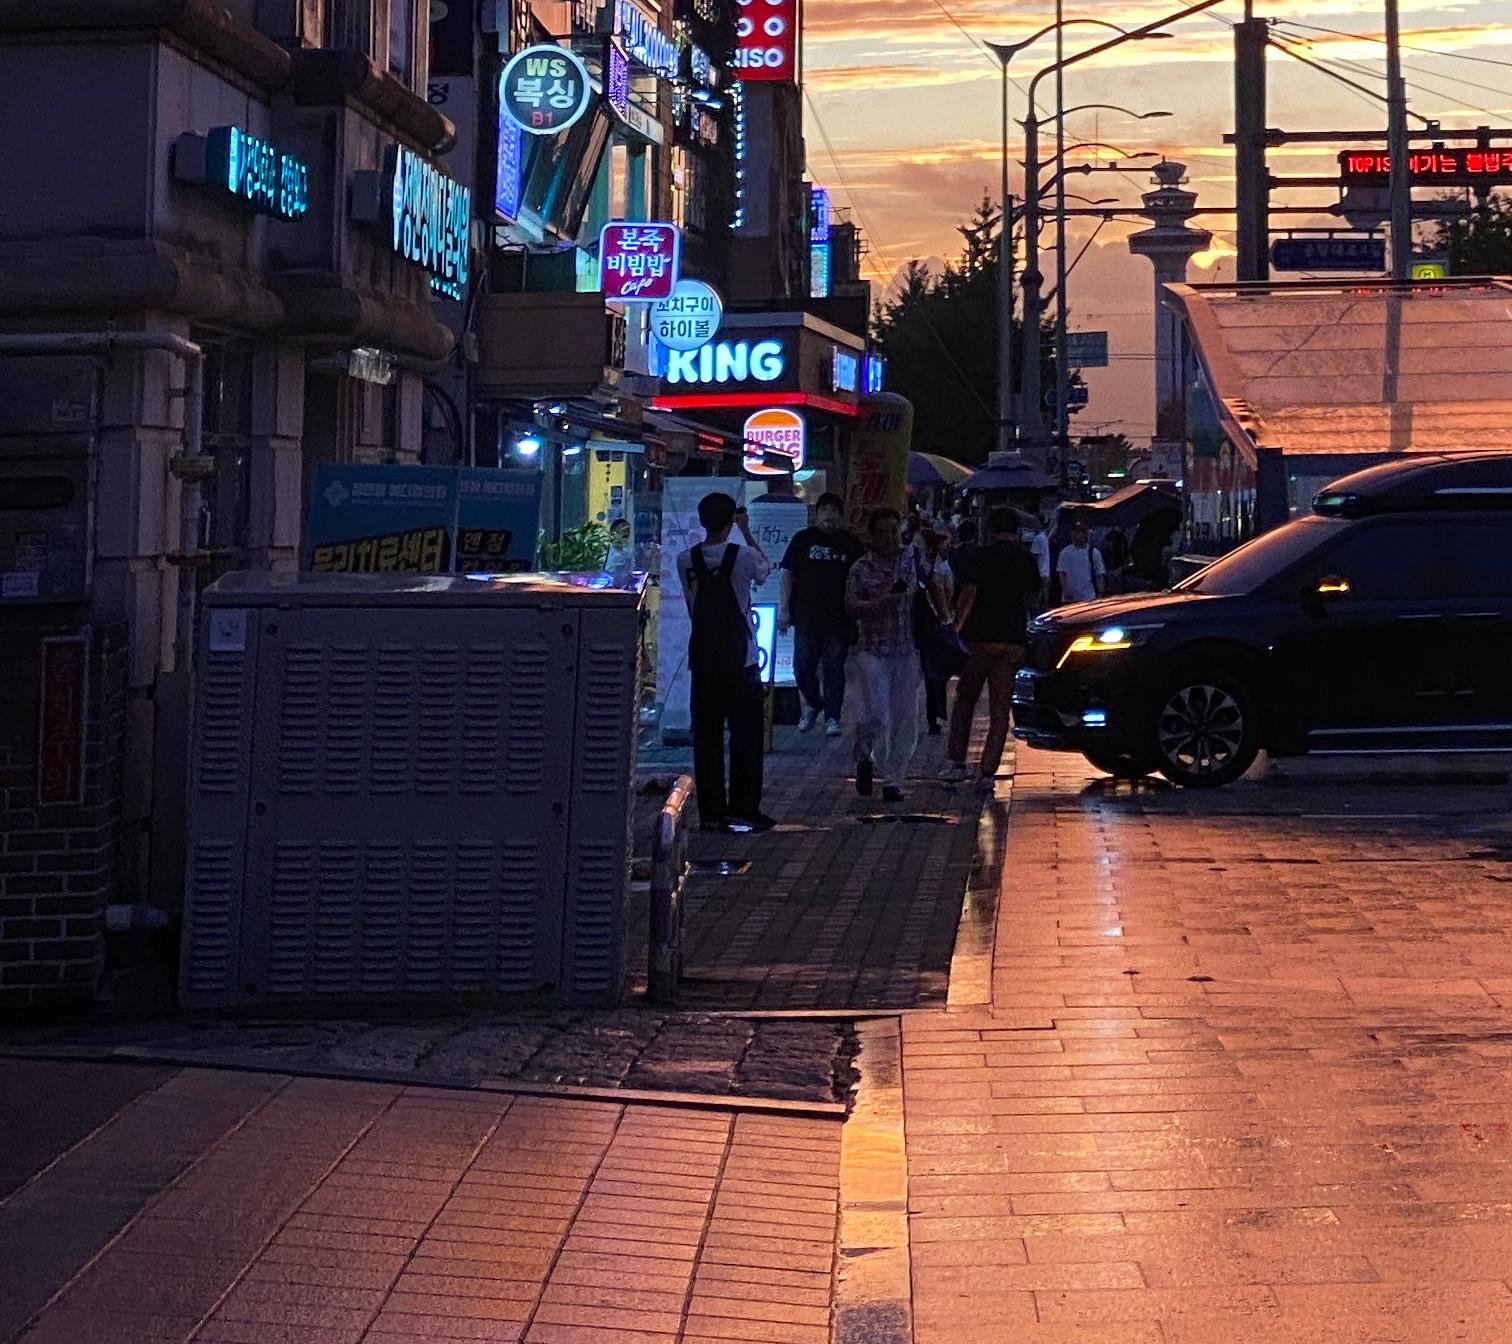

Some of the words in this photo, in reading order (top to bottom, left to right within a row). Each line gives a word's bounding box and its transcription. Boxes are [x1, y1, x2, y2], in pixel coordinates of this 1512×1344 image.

[526, 58, 567, 78] WS
[734, 47, 784, 68] ISO
[514, 79, 576, 109] 복싱
[531, 111, 553, 126] B1
[616, 228, 665, 252] 본죽
[606, 253, 671, 278] 비빔밥
[659, 319, 711, 339] 하이볼
[666, 340, 785, 384] KING
[746, 429, 801, 442] BURGER
